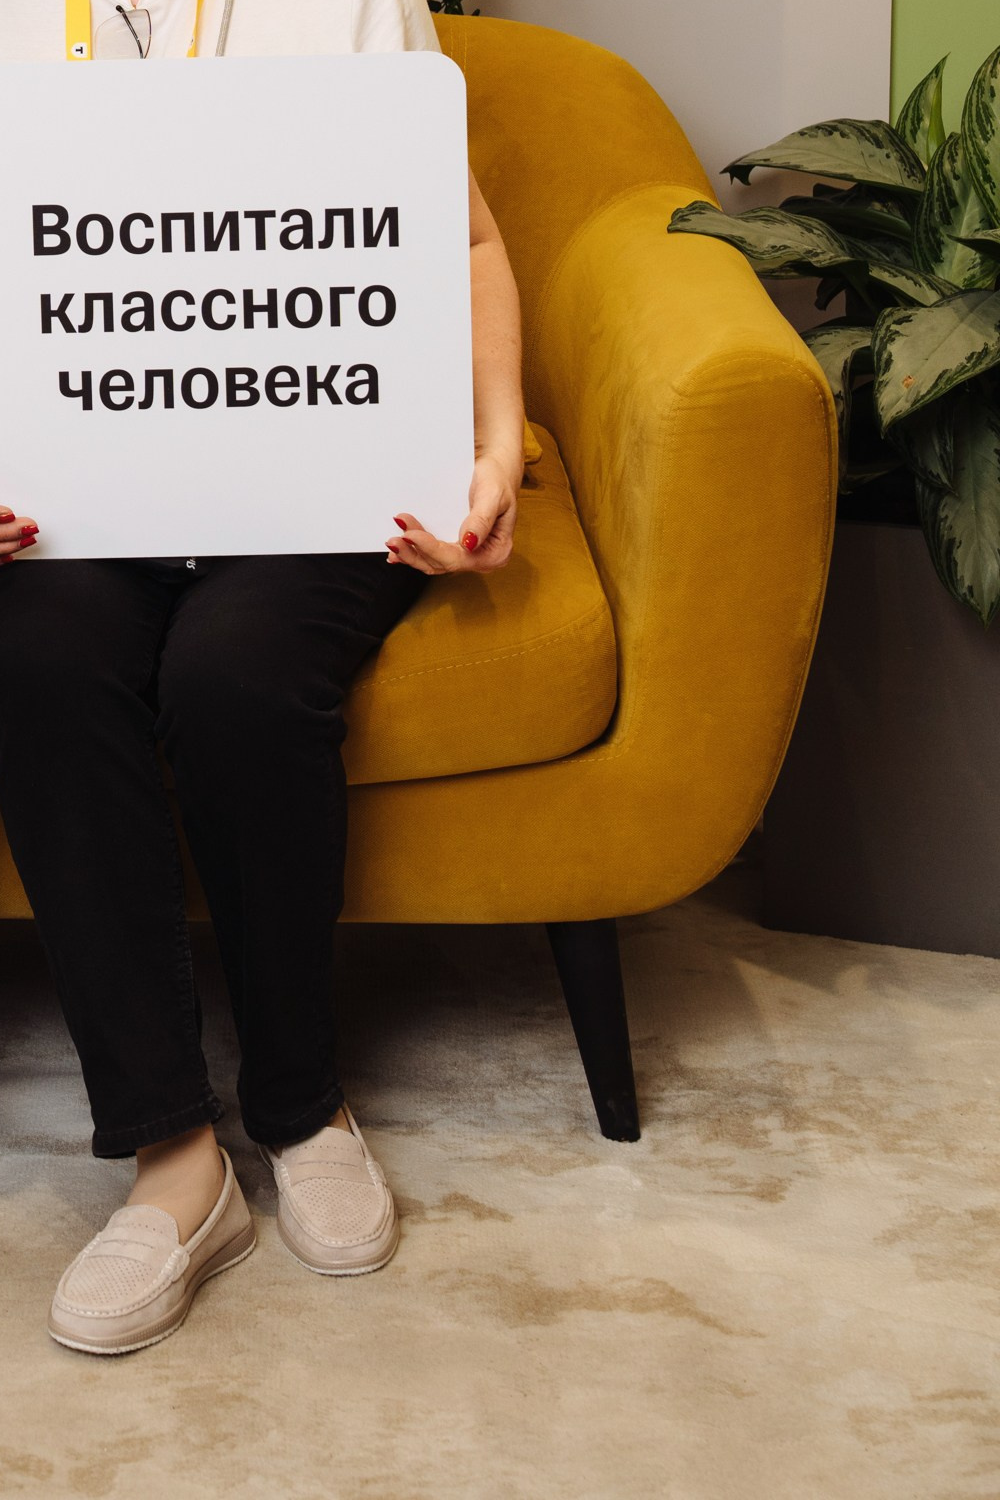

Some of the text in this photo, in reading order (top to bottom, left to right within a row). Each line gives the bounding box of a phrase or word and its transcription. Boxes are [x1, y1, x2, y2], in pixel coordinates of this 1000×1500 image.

[32, 204, 400, 256] Воспитали
[40, 284, 397, 334] классного
[58, 363, 380, 412] человека
